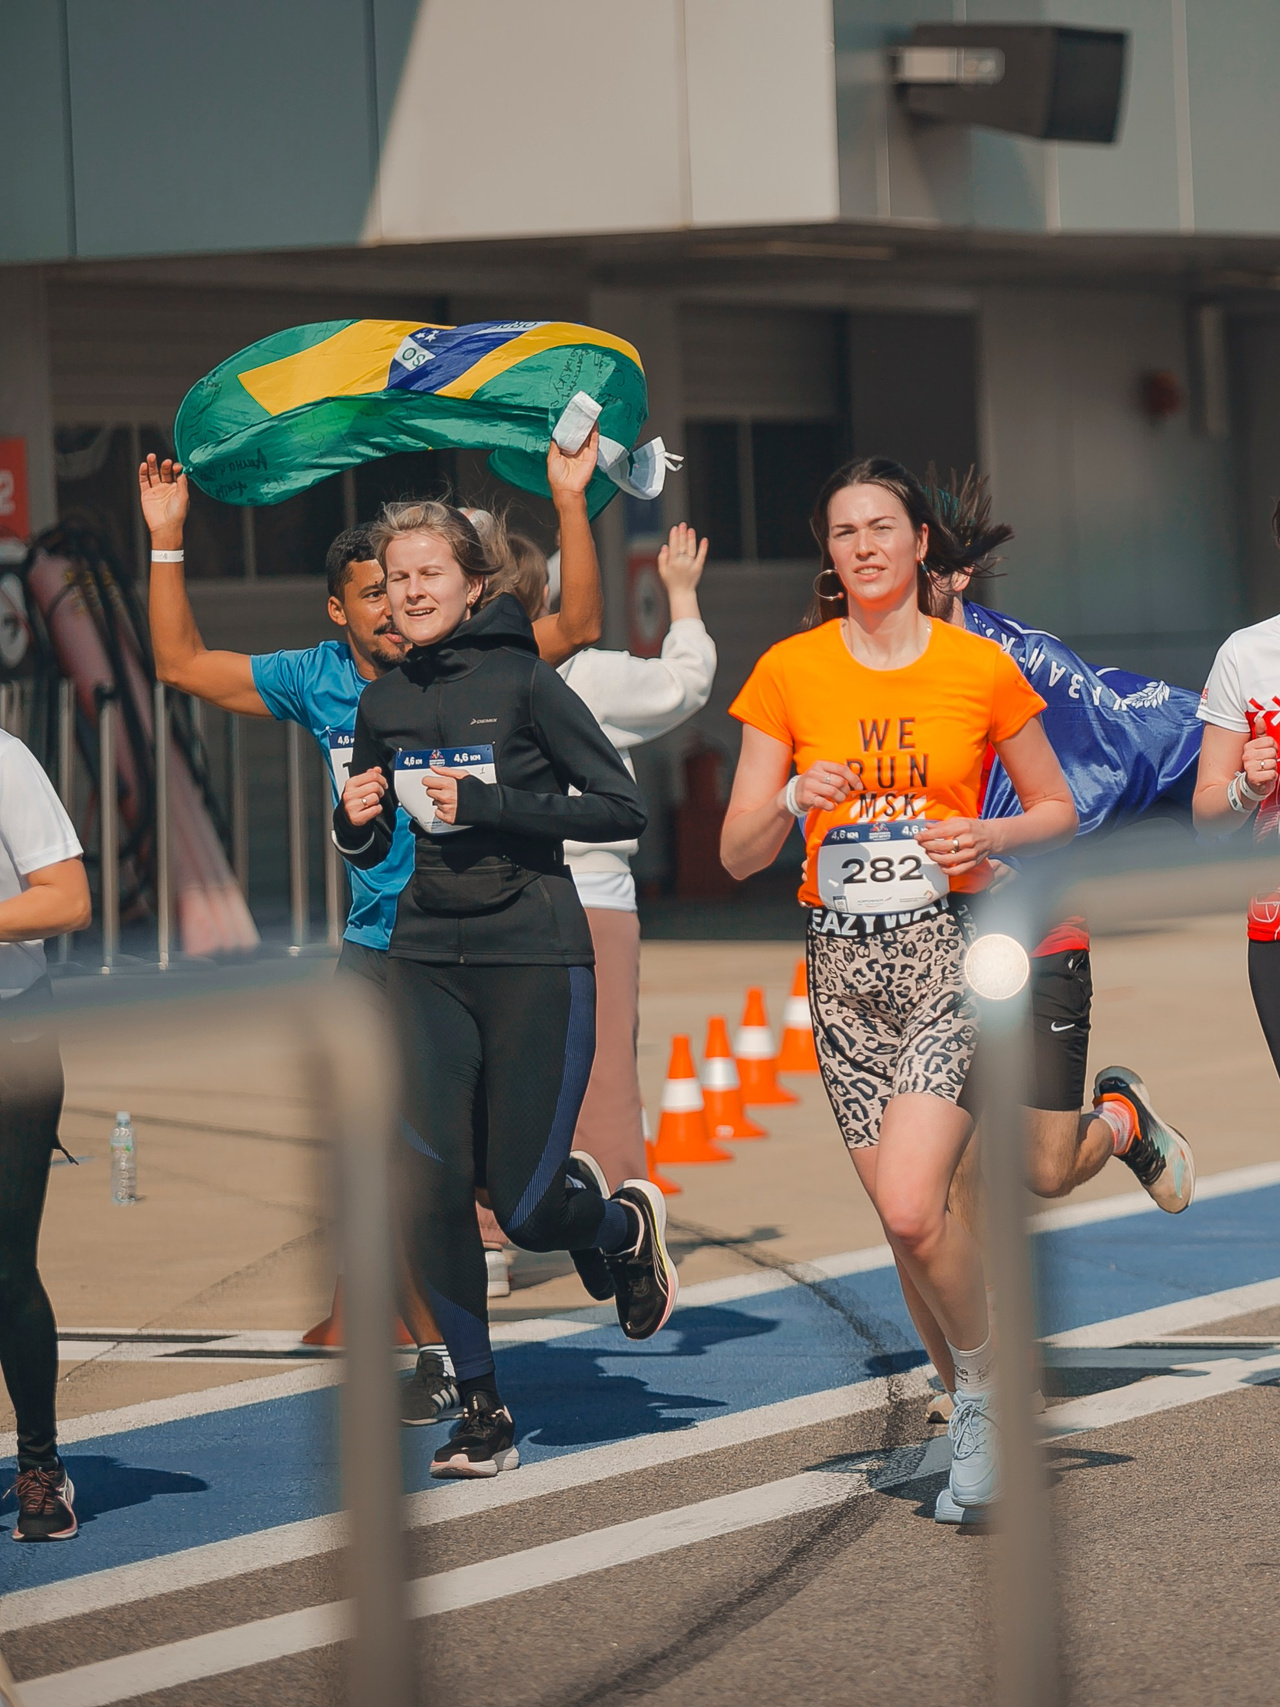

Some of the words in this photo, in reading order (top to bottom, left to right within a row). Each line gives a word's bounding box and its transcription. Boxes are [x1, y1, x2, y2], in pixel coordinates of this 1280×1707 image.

[859, 717, 916, 752] WE
[403, 756, 415, 766] 4,6
[454, 752, 469, 764] 4,6
[846, 753, 929, 791] RUN
[858, 793, 917, 818] MSK
[831, 829, 846, 840] 4,6
[901, 824, 919, 836] 4,6
[841, 854, 924, 885] 282
